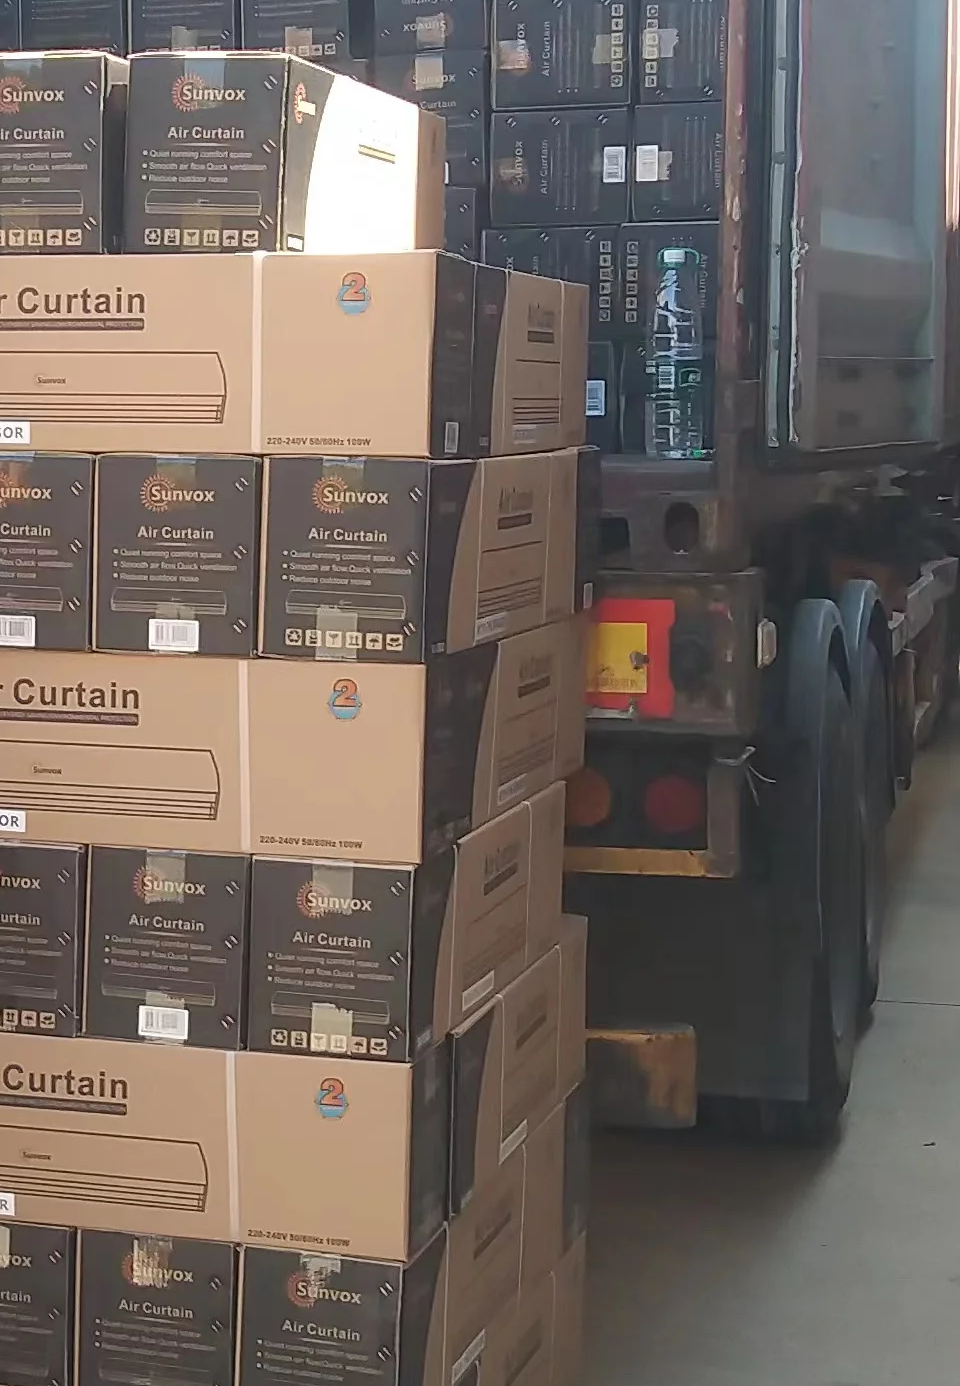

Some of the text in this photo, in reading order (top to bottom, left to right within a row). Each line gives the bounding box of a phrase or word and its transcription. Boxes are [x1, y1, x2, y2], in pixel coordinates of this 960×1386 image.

[2, 86, 65, 104] Sunvox
[181, 85, 247, 103] Sunvox
[13, 126, 65, 140] Curtain
[167, 125, 245, 140] Air Curtain
[17, 286, 147, 315] Curtain
[151, 486, 216, 504] Sunvox
[322, 488, 389, 506] Sunvox
[0, 522, 52, 537] Curtain
[137, 525, 215, 540] Air Curtain
[308, 527, 388, 543] Air Curtain
[12, 677, 141, 710] Curtain
[142, 876, 206, 896] Sunvox
[307, 892, 373, 912] Sunvox
[129, 914, 205, 933] Air Curtain
[292, 931, 372, 949] Air Curtain
[2, 1063, 129, 1100] Curtain
[296, 1281, 362, 1305] Sunvox
[119, 1298, 194, 1320] Air Curtain
[282, 1318, 361, 1342] Air Curtain
